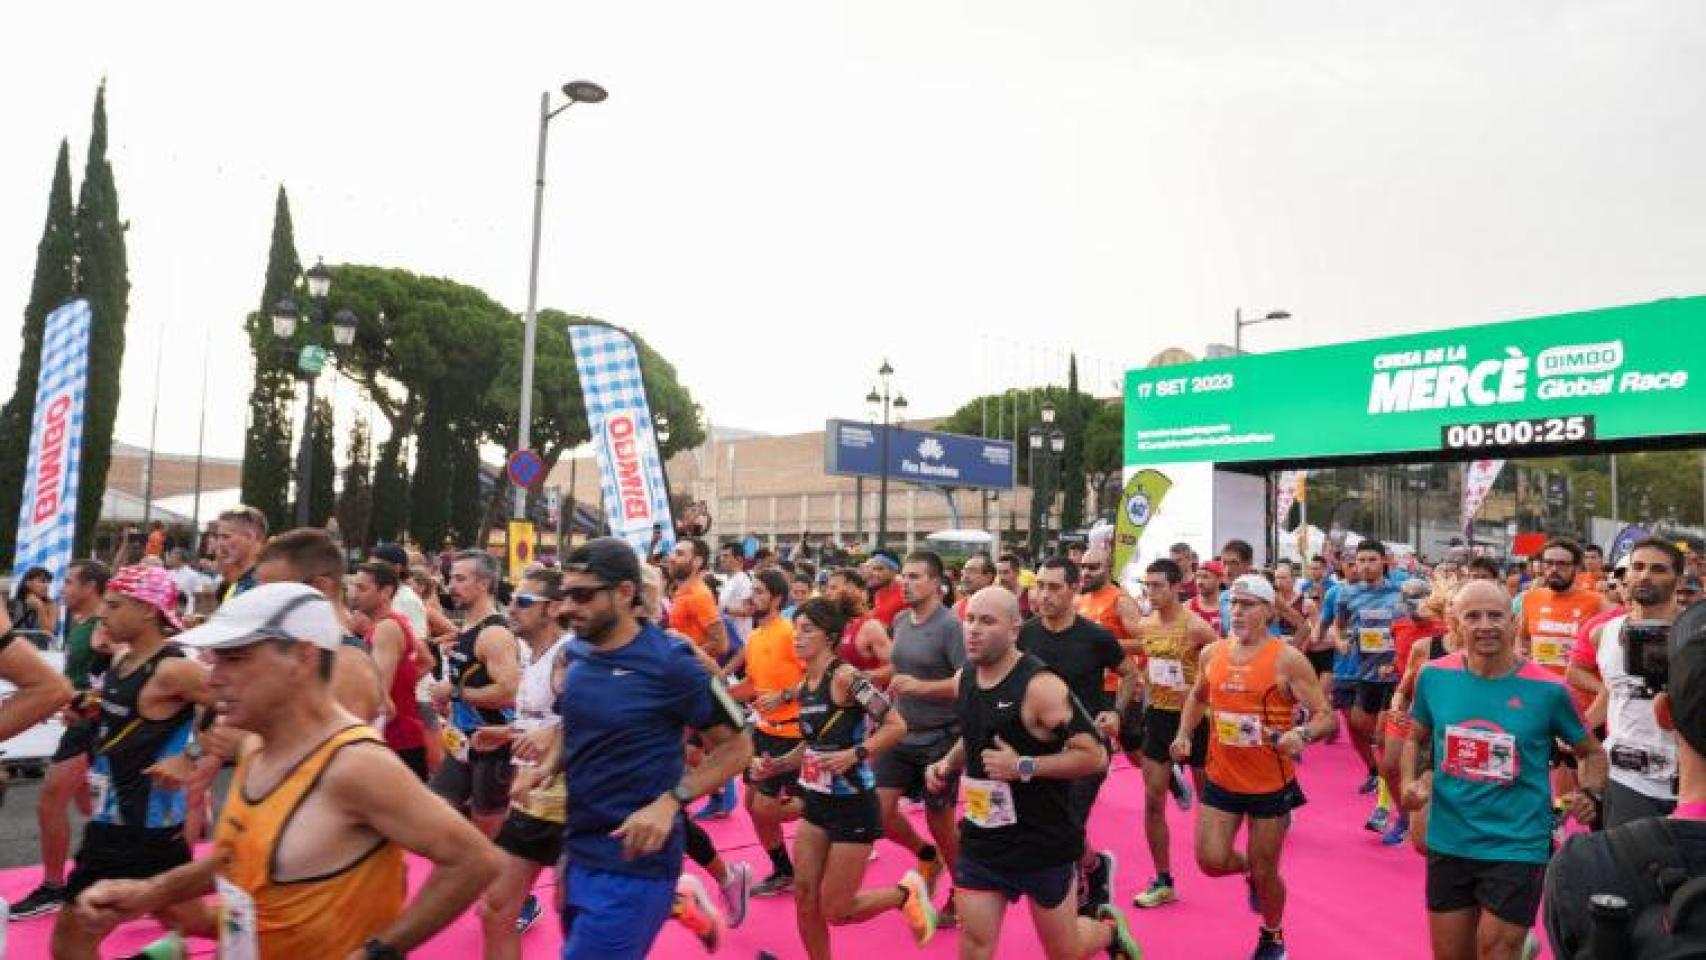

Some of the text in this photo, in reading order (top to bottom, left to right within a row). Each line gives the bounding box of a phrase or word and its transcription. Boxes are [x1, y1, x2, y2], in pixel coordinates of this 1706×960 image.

[1448, 345, 1466, 360] LA
[1545, 349, 1616, 369] BIMBO
[1137, 374, 1233, 398] 17 SET 2023
[1367, 346, 1529, 414] MERCÈ
[1537, 371, 1688, 400] Global Race
[1448, 416, 1585, 447] 00:00:25
[34, 395, 70, 523] BIMBO
[610, 416, 649, 519] BIMBO
